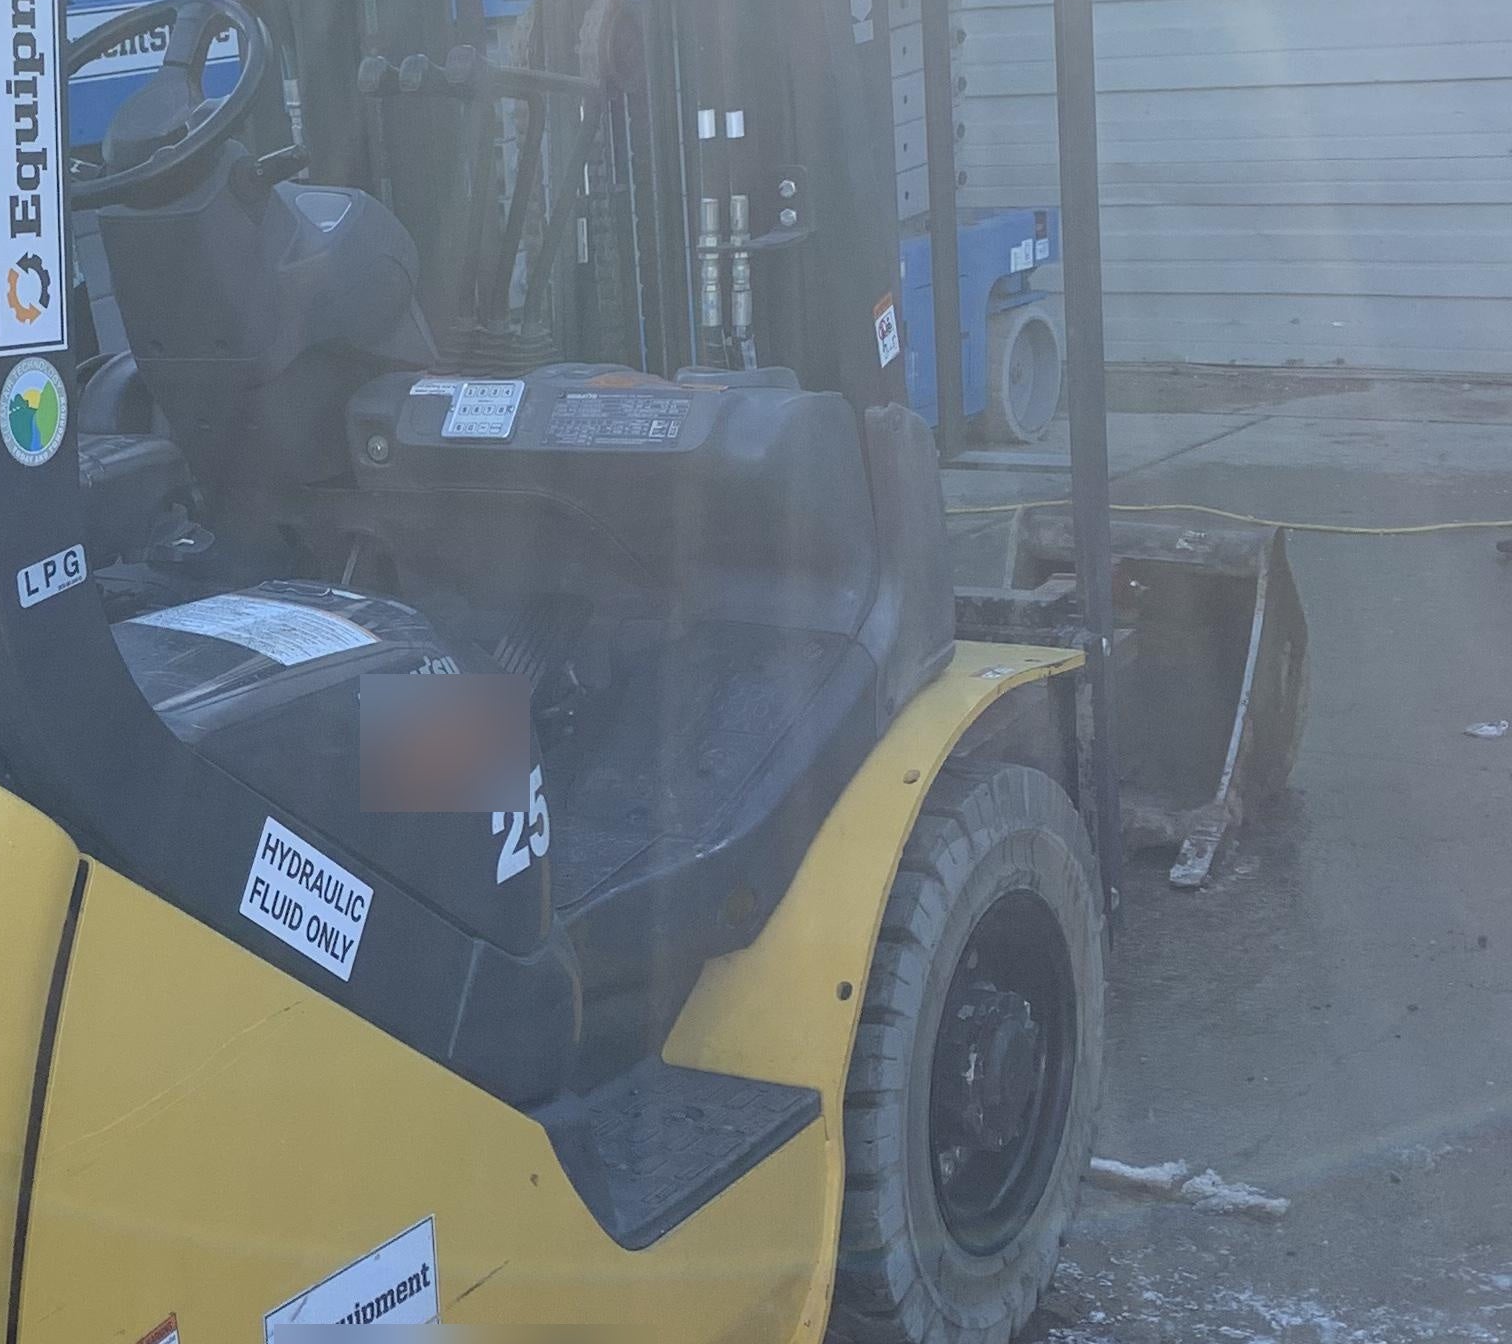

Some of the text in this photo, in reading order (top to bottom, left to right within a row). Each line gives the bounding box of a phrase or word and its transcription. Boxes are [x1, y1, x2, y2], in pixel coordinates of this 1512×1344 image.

[24, 550, 80, 597] LPG
[491, 763, 551, 885] 25
[248, 876, 355, 964] FLUID ONLY
[260, 832, 366, 924] HYDRAULIC
